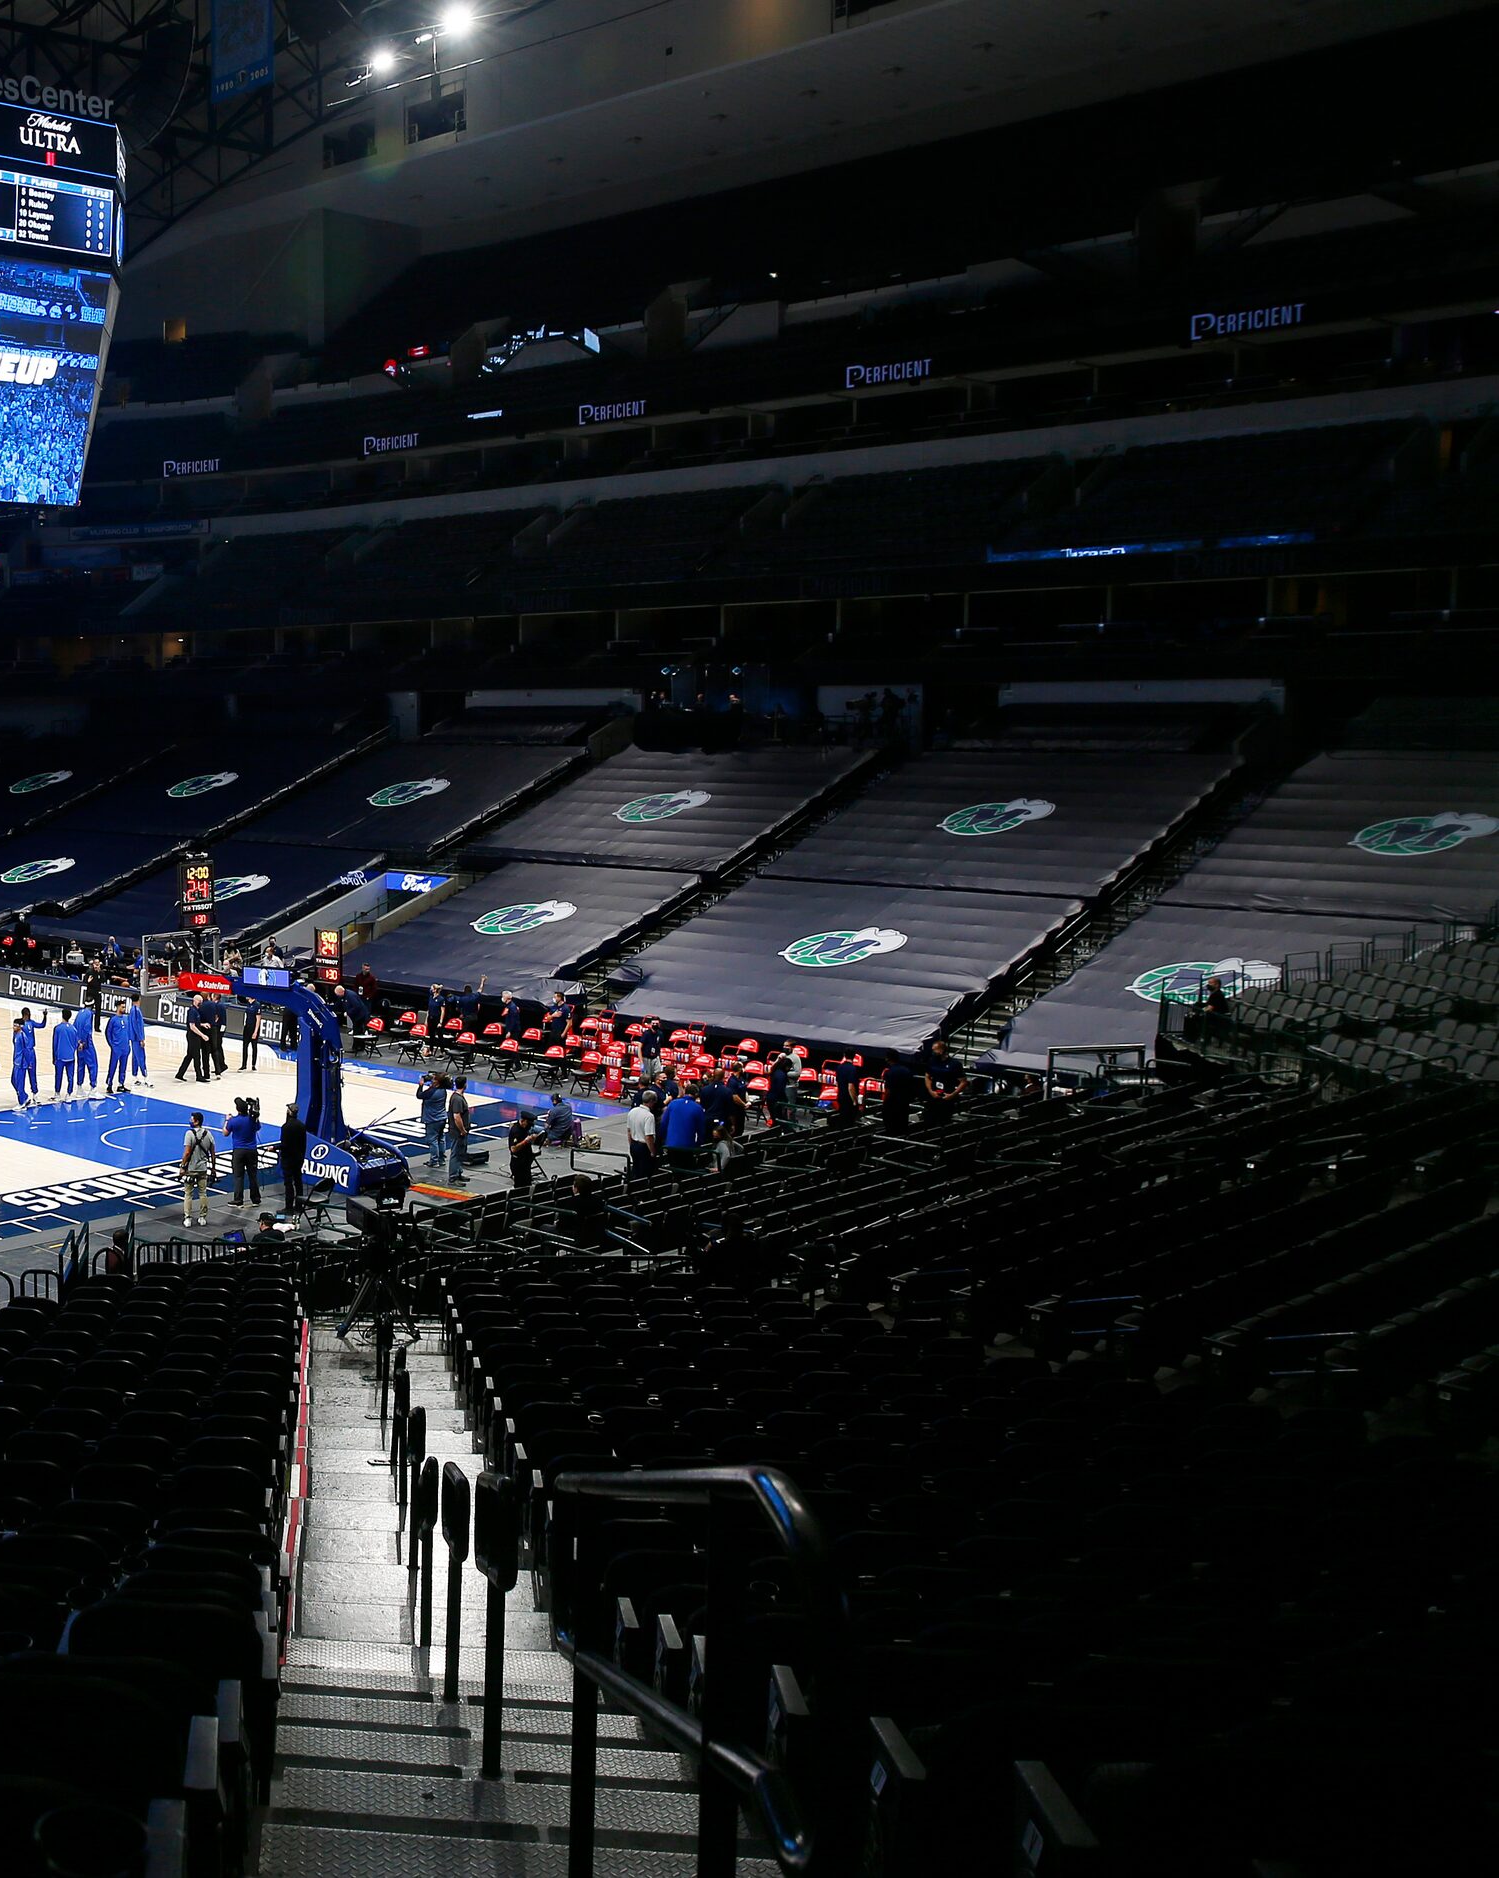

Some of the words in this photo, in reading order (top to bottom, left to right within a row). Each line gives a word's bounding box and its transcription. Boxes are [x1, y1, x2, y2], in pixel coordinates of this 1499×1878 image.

[19, 126, 82, 155] ULTRA
[28, 199, 48, 210] Rubio
[1190, 302, 1307, 341] PERFICIENT
[846, 358, 932, 389] PERFICIENT
[579, 400, 647, 426] PERFICIENT
[363, 432, 420, 457] PERFICIENT
[164, 458, 221, 478] PERFICIENT
[186, 866, 209, 880] 12:00
[187, 880, 207, 901] 24
[401, 874, 432, 893] Ford
[192, 903, 213, 911] TISSOT
[195, 914, 206, 925] 1:30
[321, 931, 338, 944] 12:00
[321, 943, 336, 955] 24
[322, 958, 339, 966] TISSOT
[325, 969, 338, 981] 1:30
[9, 974, 64, 1002] PERFICIENT
